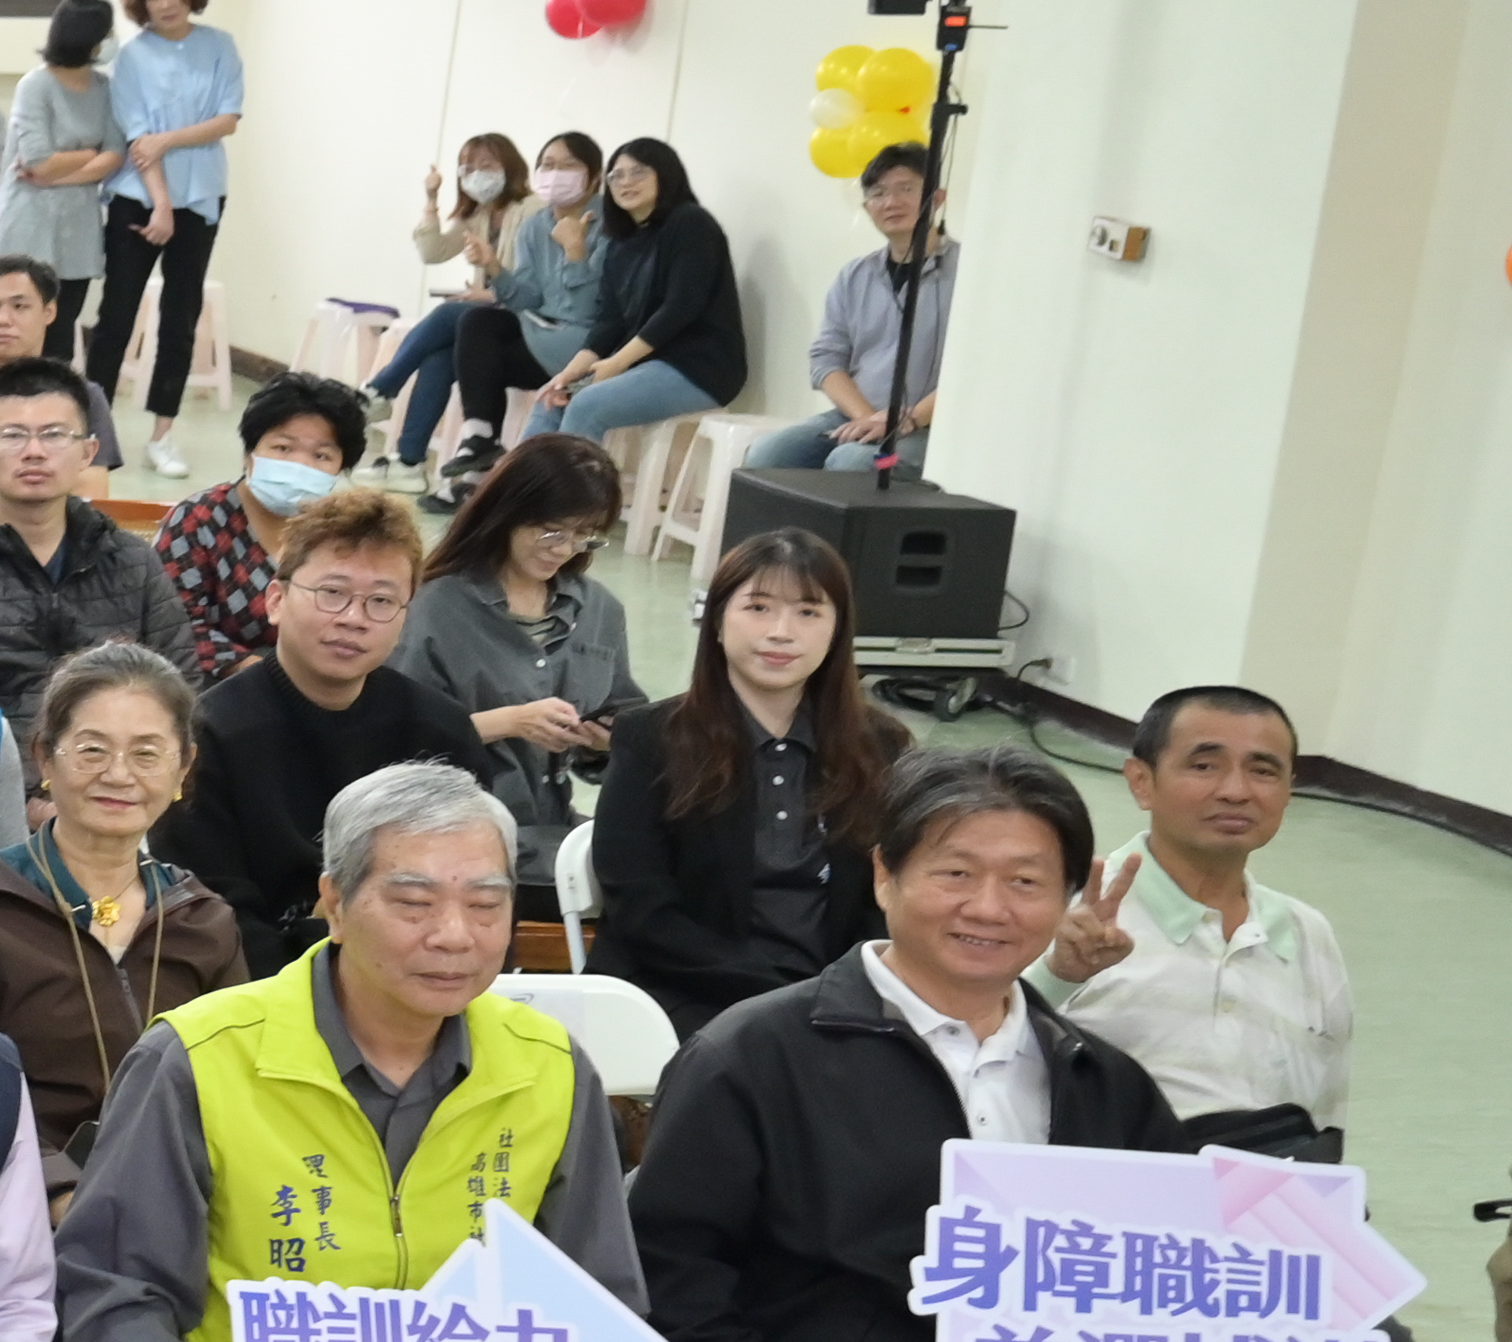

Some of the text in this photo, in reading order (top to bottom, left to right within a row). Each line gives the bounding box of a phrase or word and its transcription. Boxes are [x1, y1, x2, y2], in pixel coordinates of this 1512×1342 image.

[269, 1184, 307, 1274] 李昭
[302, 1152, 342, 1252] 理事長
[922, 1206, 1323, 1322] 身障職訓
